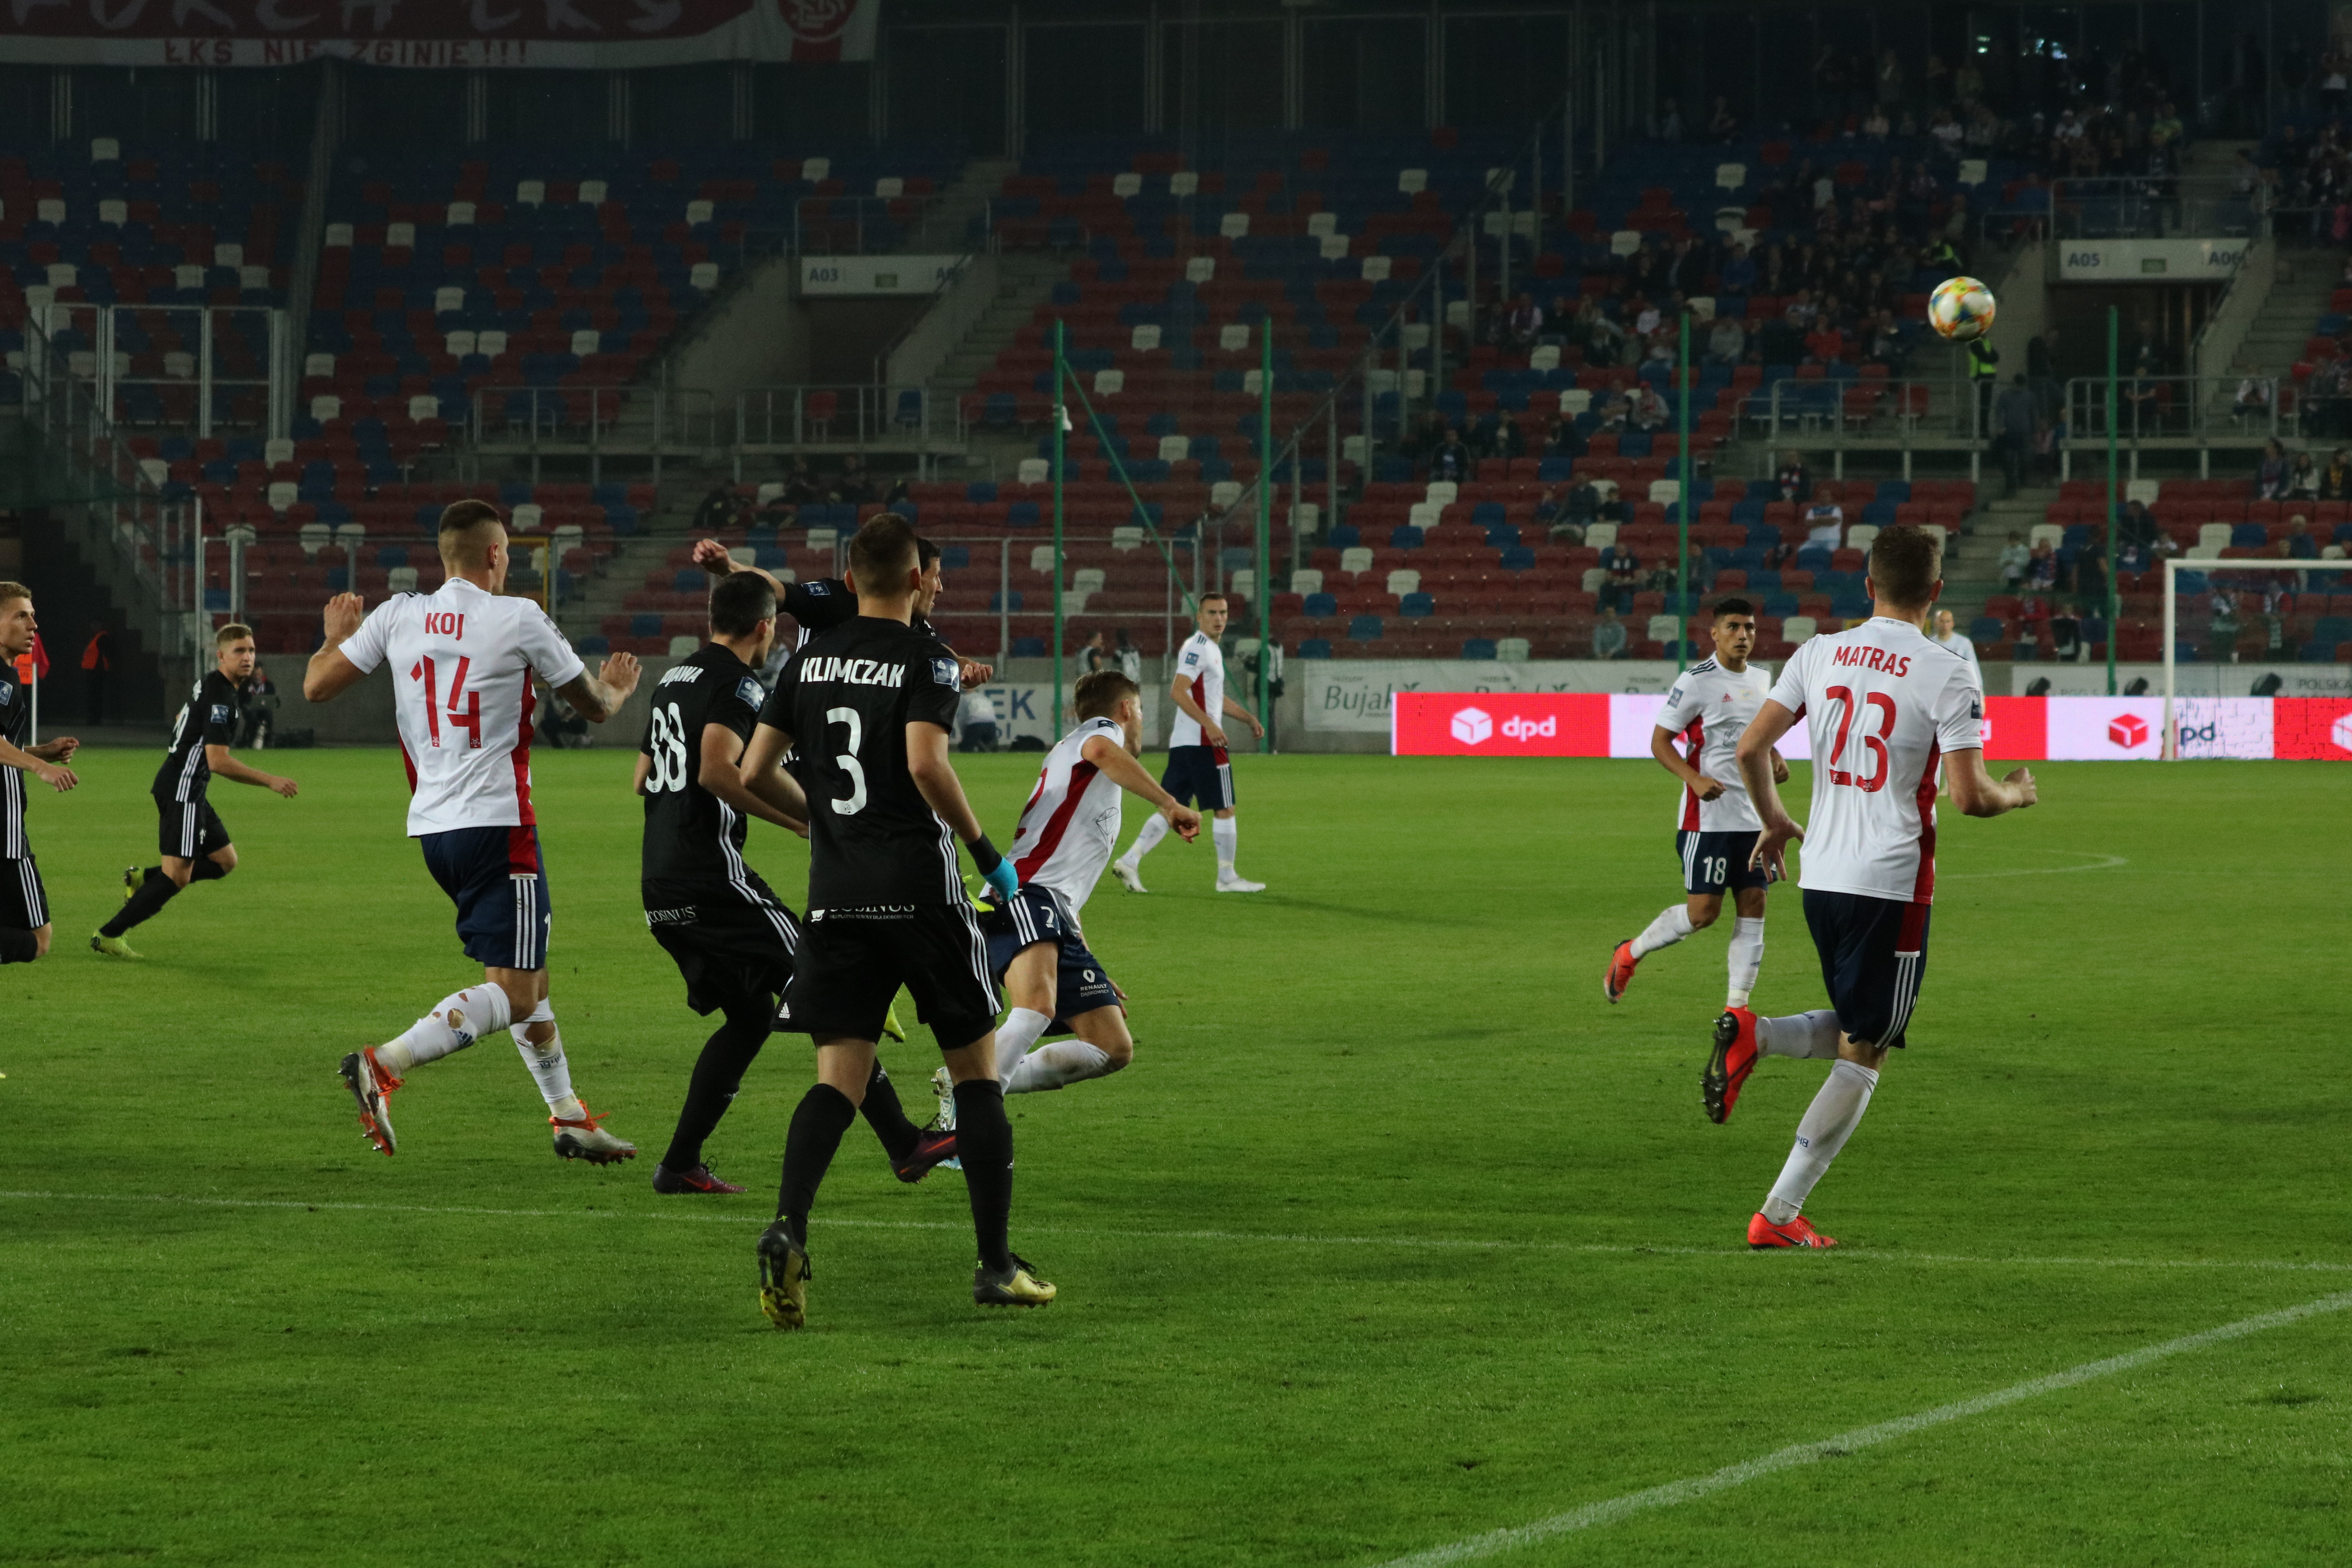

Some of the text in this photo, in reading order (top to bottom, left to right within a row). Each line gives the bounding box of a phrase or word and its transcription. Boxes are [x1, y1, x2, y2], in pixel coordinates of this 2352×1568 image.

[164, 39, 232, 63] ŁKS
[2068, 252, 2100, 267] A05
[809, 268, 838, 282] A03
[425, 612, 465, 641] KOJ
[800, 656, 906, 688] KLIMCZAK
[1832, 646, 1911, 678] MATRAS
[410, 654, 481, 748] 14
[1501, 715, 1557, 742] dpd
[1826, 685, 1896, 792] 23
[826, 707, 867, 815] 3
[1703, 856, 1727, 885] 18
